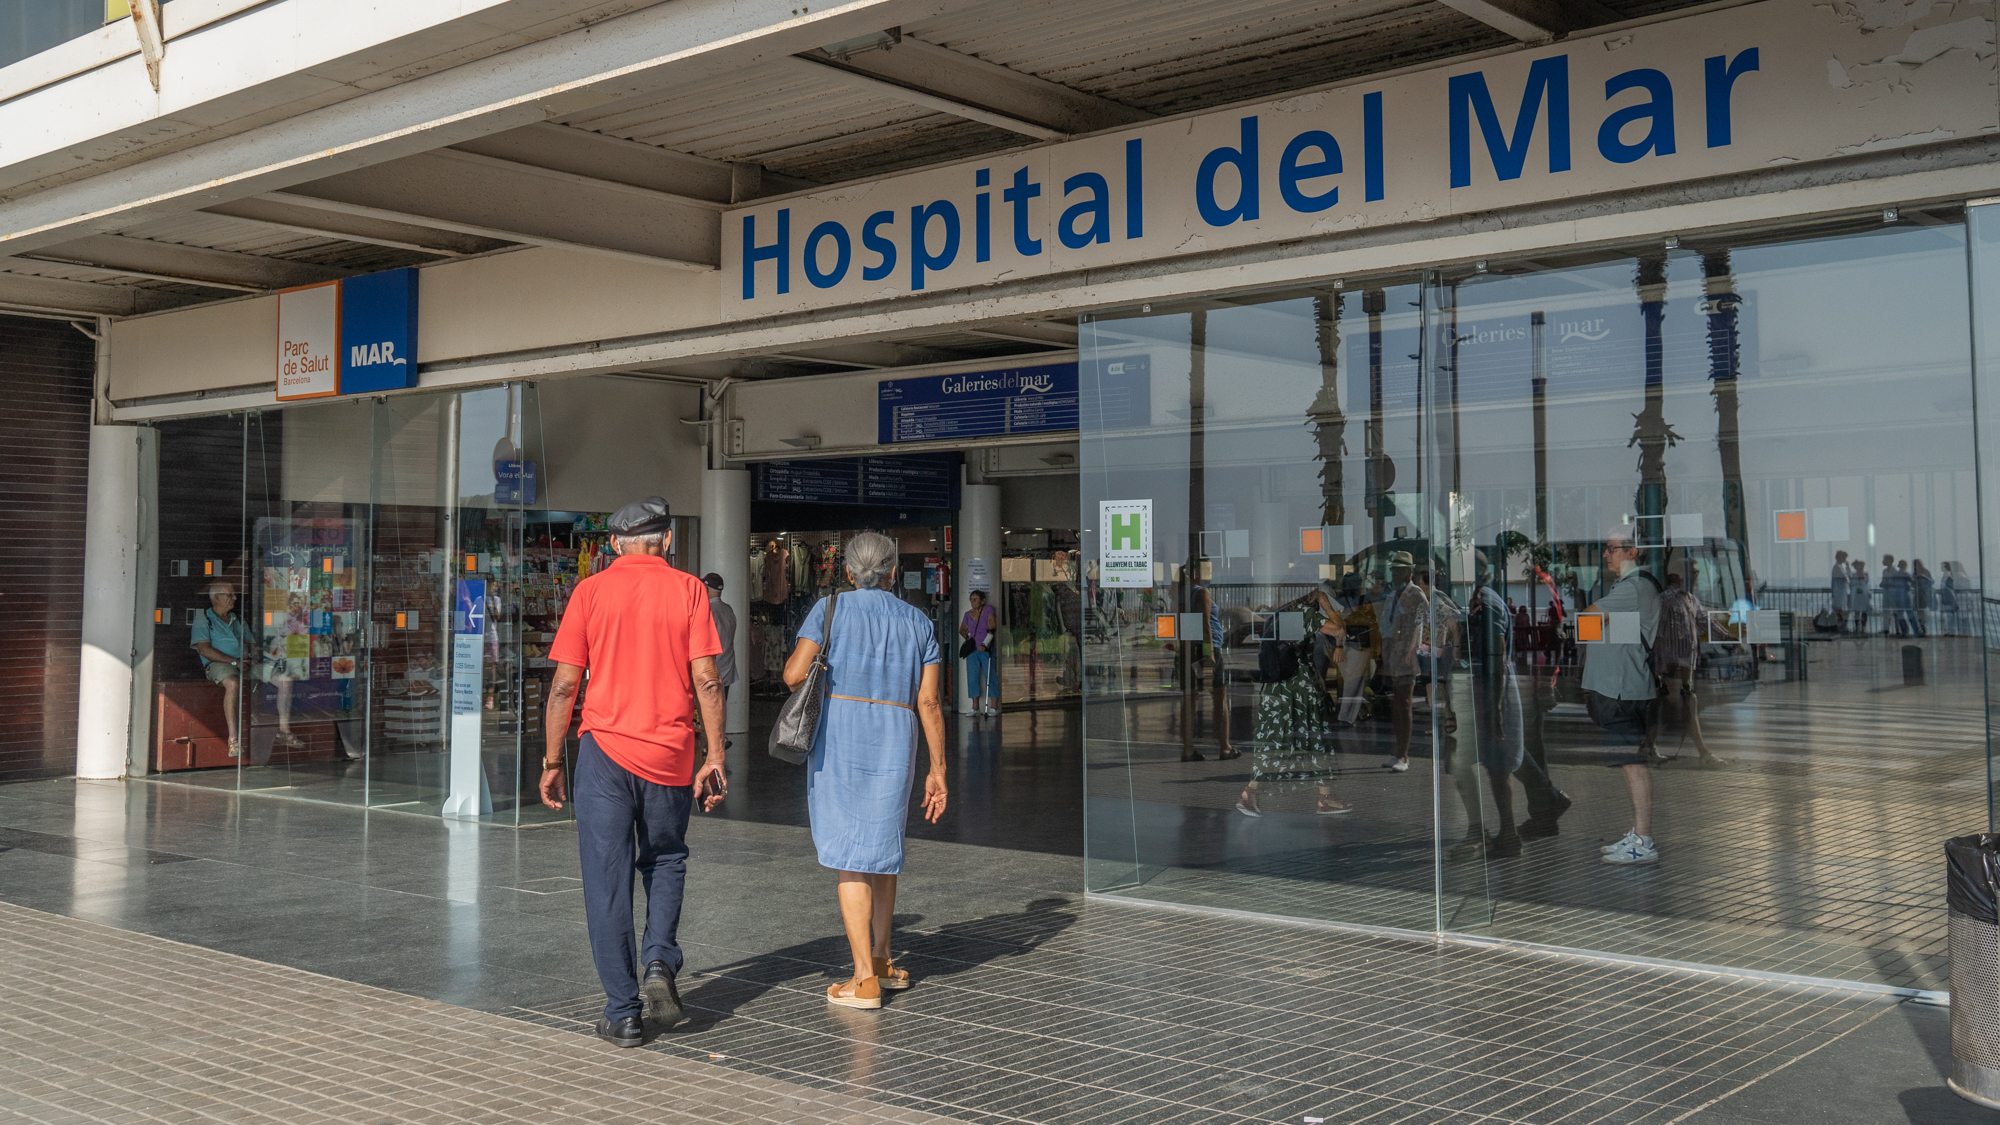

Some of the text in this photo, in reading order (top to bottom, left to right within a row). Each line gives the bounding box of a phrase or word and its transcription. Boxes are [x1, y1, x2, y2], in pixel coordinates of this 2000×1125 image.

[742, 47, 1760, 299] Hospital del Mar
[284, 340, 309, 358] Parc
[351, 341, 395, 368] MAR
[283, 354, 329, 376] de Salut
[283, 376, 311, 386] Barcelona
[1111, 513, 1141, 551] H
[1134, 560, 1148, 568] TABAC
